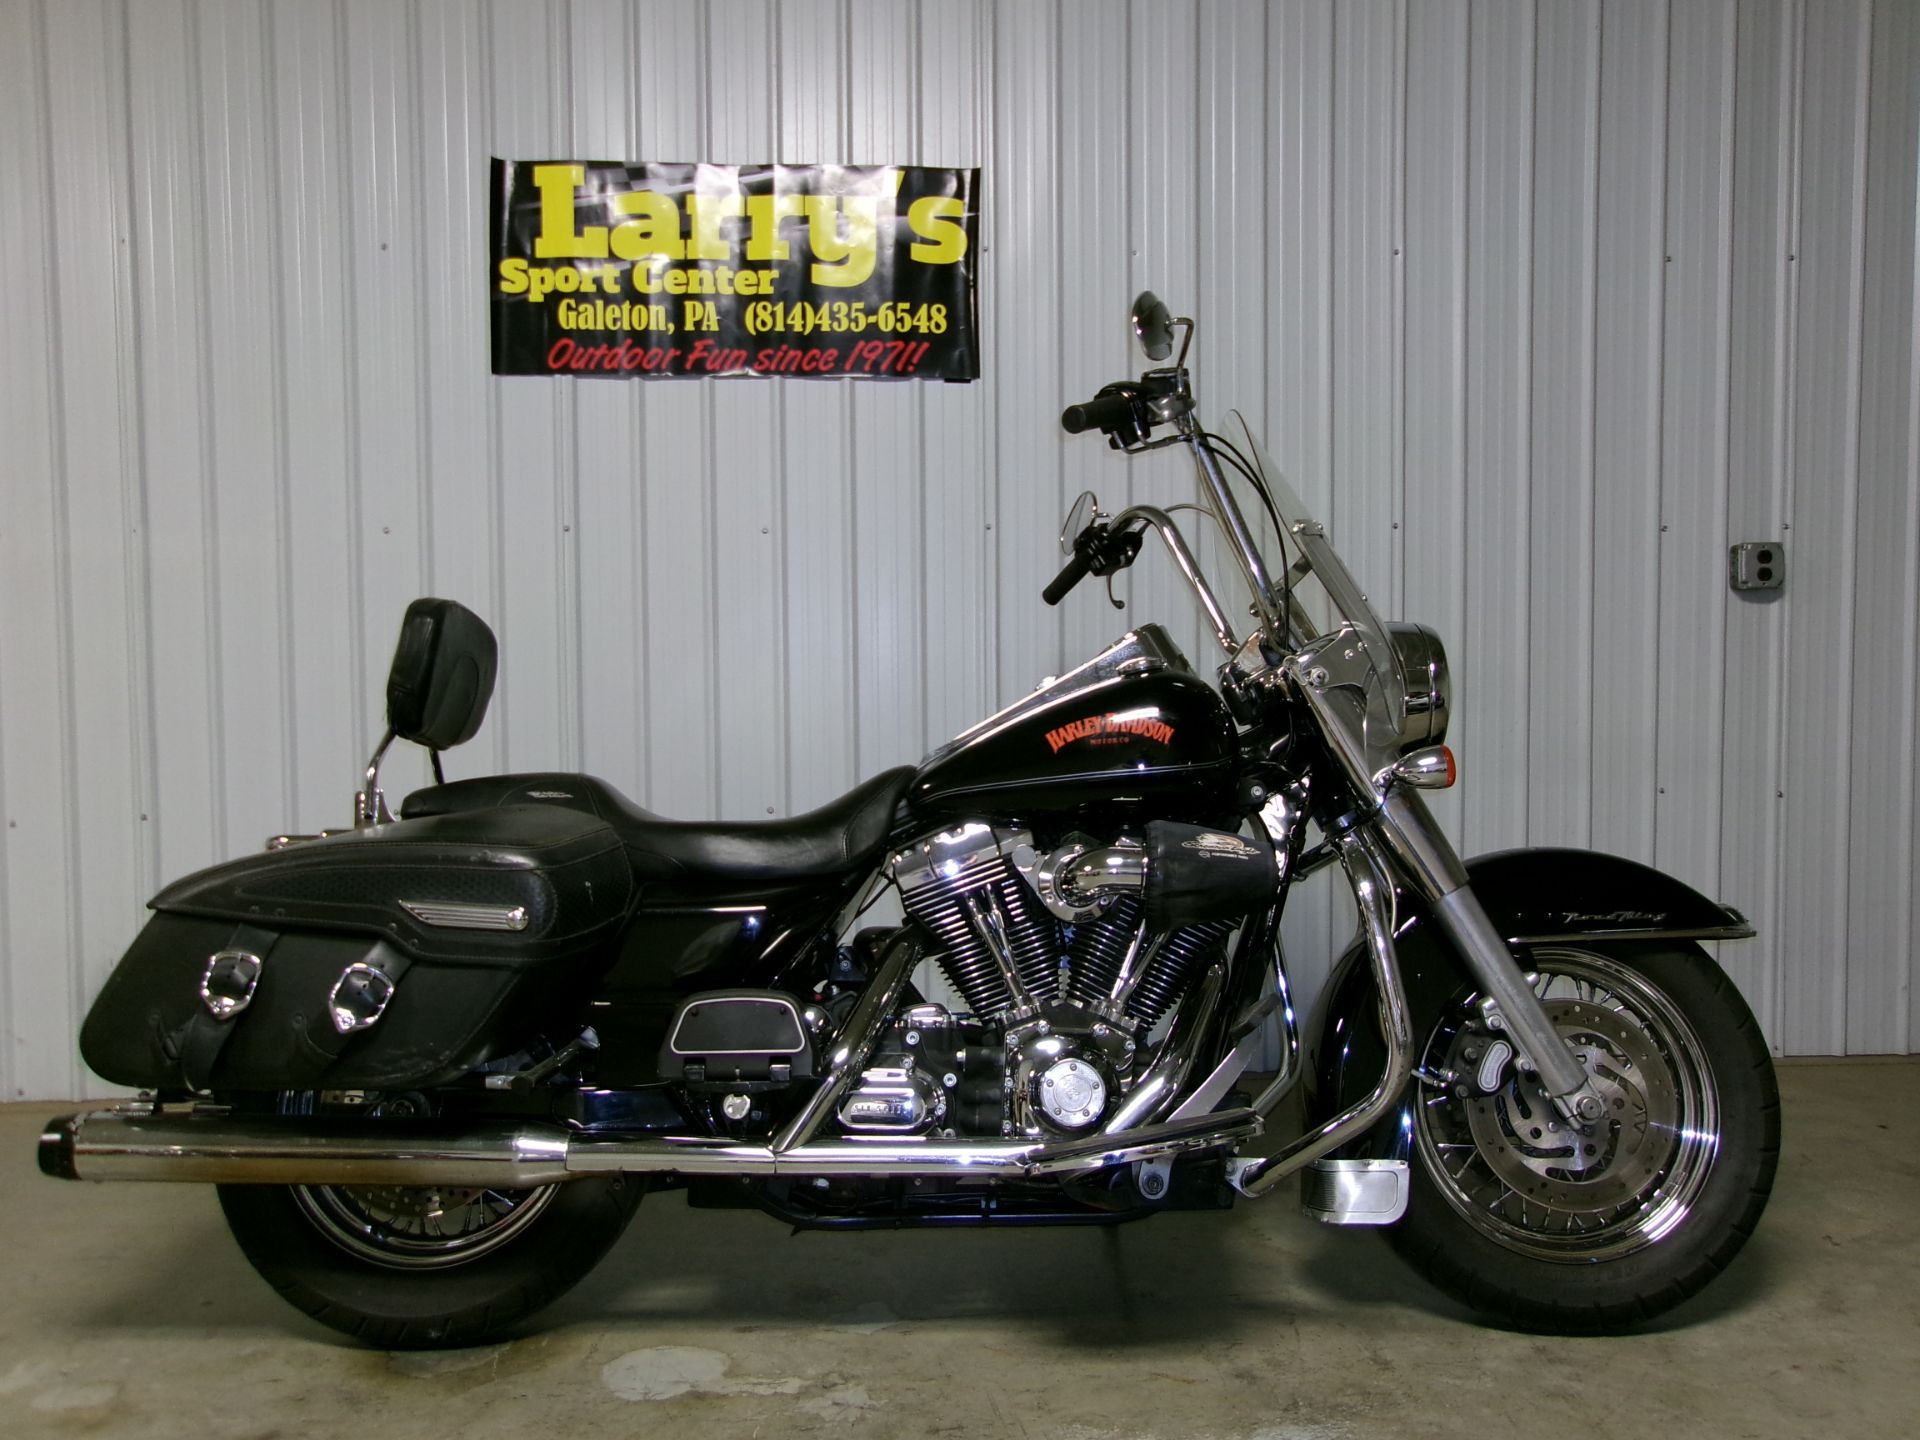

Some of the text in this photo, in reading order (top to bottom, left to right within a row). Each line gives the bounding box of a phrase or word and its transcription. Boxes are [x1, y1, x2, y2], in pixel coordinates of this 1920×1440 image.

[533, 164, 968, 288] Larry's
[499, 257, 780, 303] Sport Center
[558, 298, 948, 336] Galeton, PA (814)435-6548
[547, 337, 682, 371] Outdoor
[684, 338, 747, 371] Fun
[754, 344, 838, 373] since
